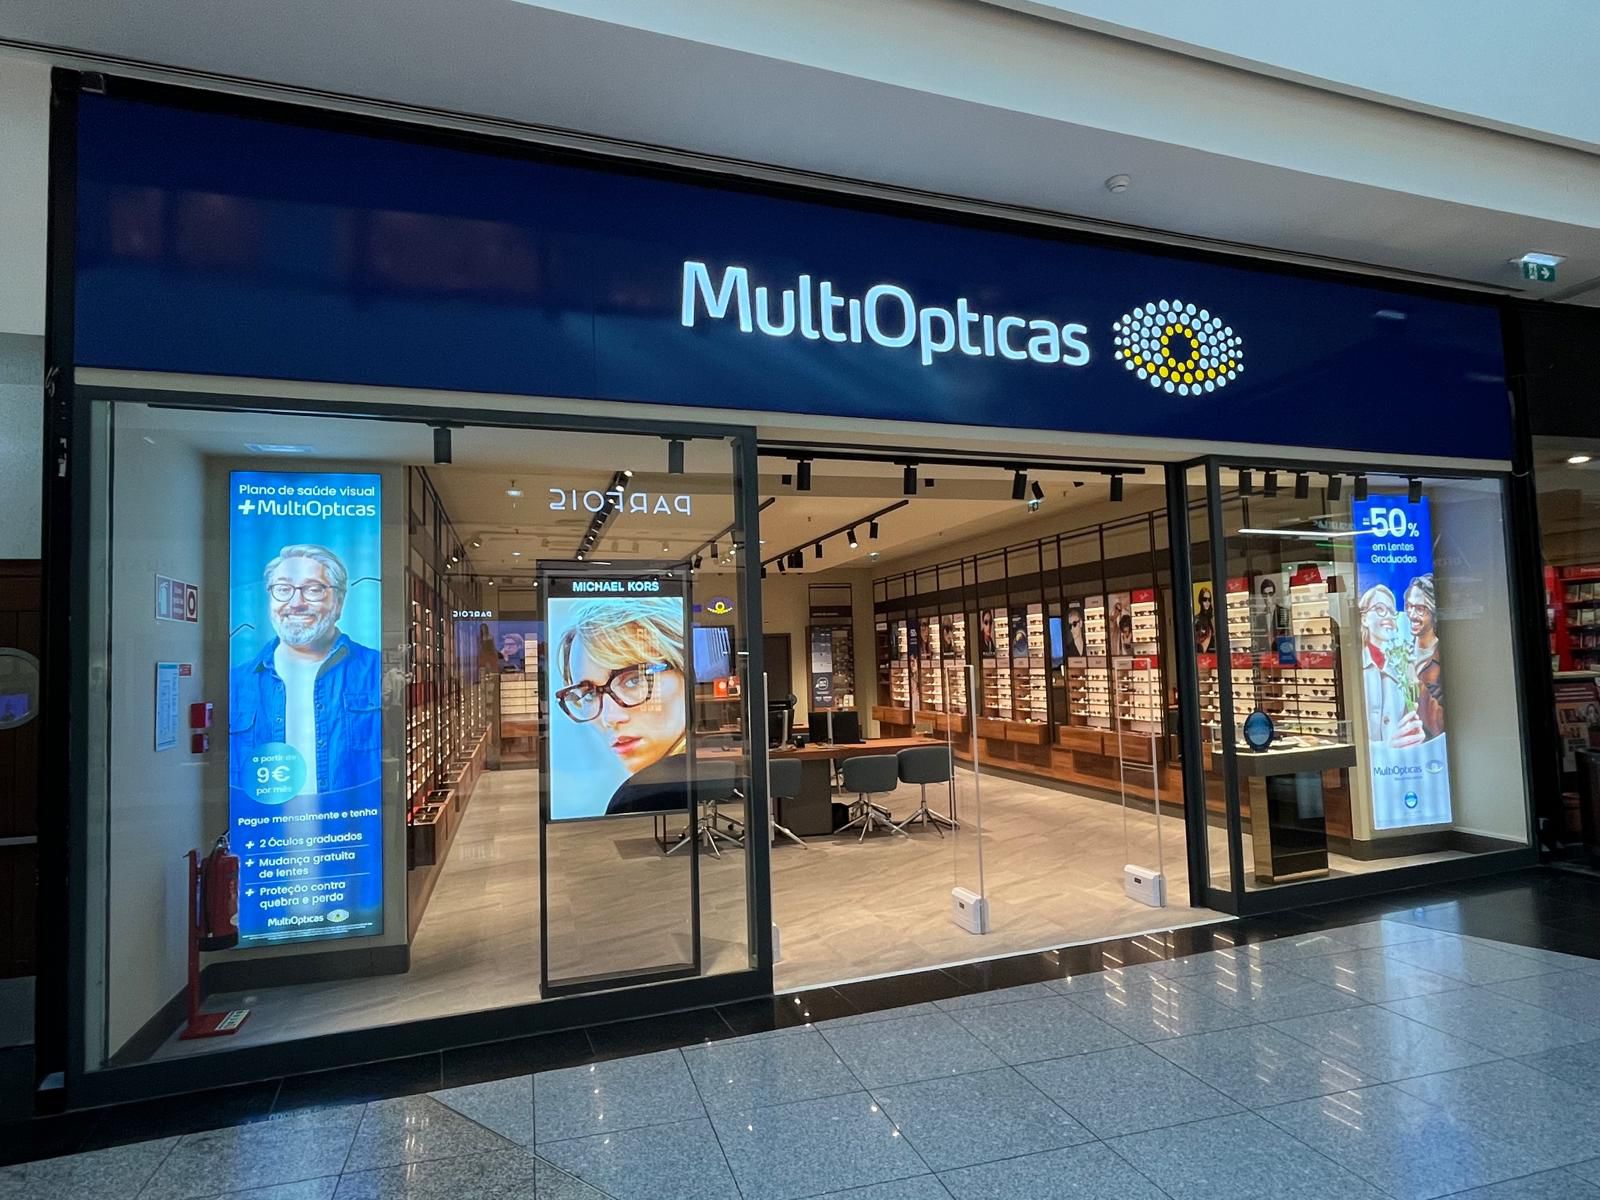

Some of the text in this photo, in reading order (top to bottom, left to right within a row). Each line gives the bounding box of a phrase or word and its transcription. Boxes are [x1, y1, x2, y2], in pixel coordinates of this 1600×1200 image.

[681, 260, 1090, 367] MultiOpticas
[239, 484, 375, 497] Plano de saúde visual
[1372, 542, 1415, 551] em Lentes
[572, 581, 660, 592] MICHAEL KORS
[260, 754, 283, 764] partir
[256, 787, 271, 796] por
[238, 817, 270, 827] Pague
[272, 810, 340, 823] mensalmente
[349, 808, 378, 817] tenha
[259, 839, 266, 848] 2
[306, 832, 363, 846] graduados
[259, 855, 310, 867] Mudança
[312, 851, 356, 865] gratuita
[259, 867, 309, 879] de lentes
[259, 884, 308, 896] Proteção
[310, 881, 346, 891] contra
[259, 892, 344, 910] quebra e perda
[267, 915, 324, 927] MultiOpticas
